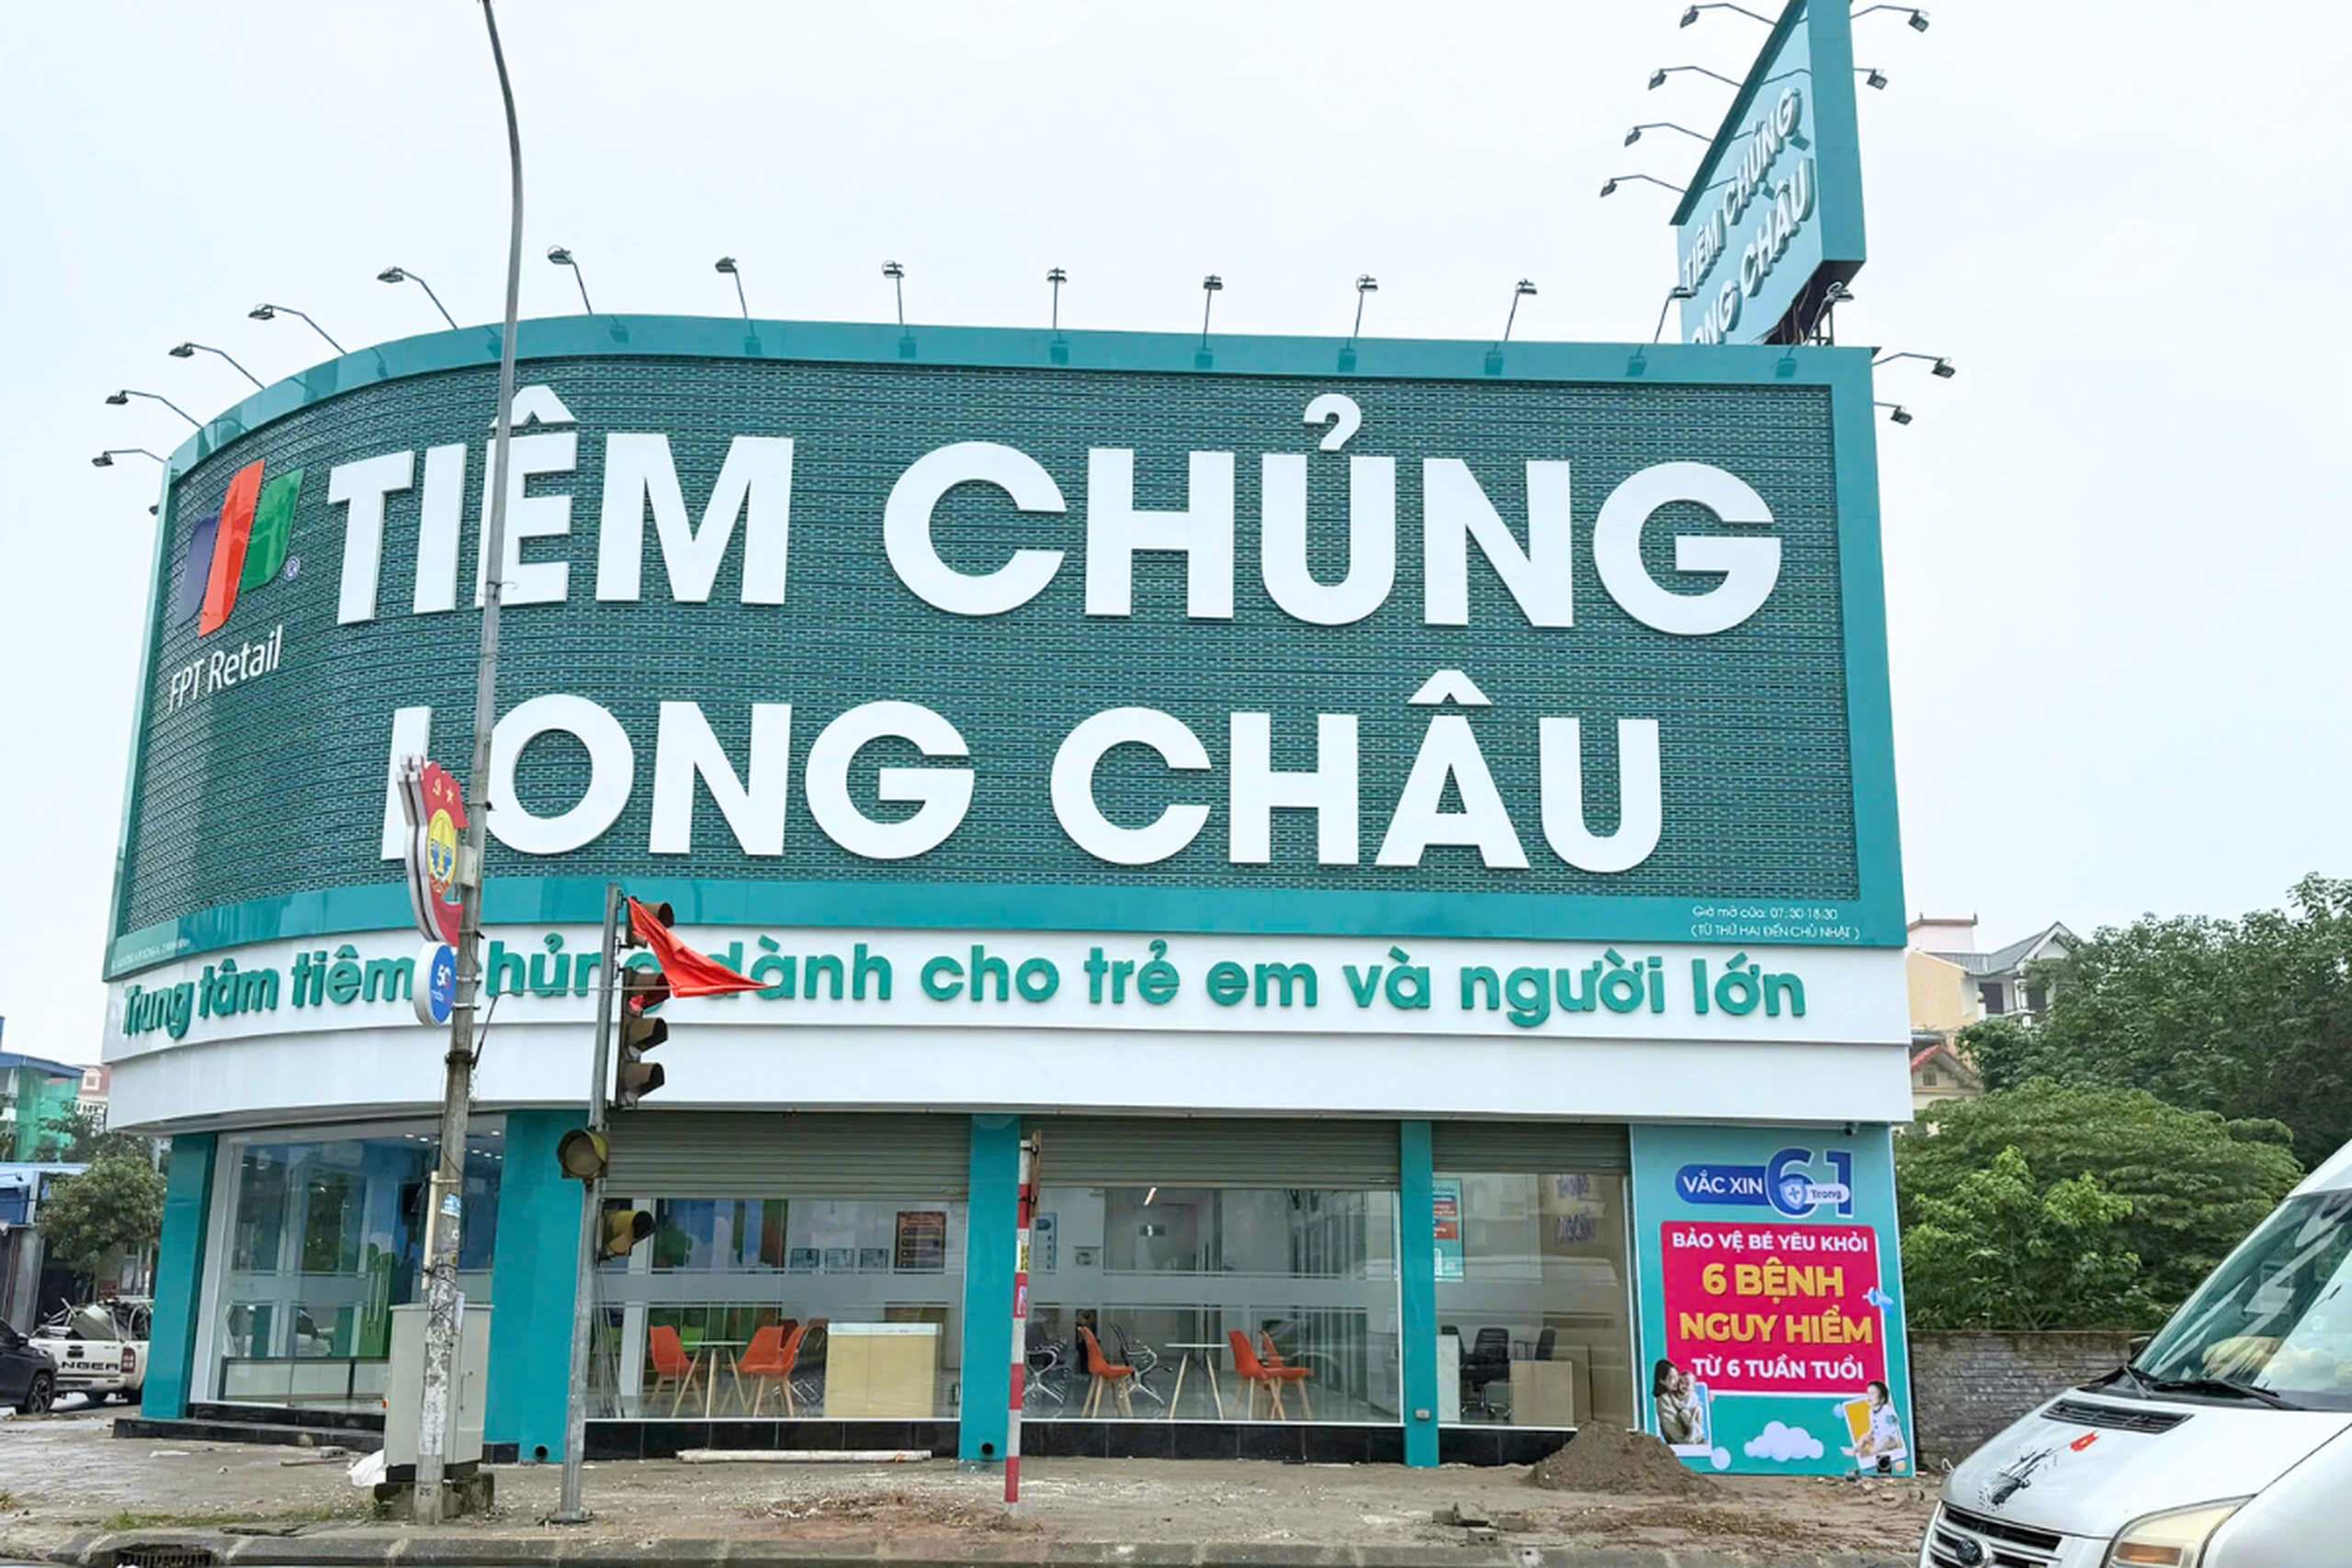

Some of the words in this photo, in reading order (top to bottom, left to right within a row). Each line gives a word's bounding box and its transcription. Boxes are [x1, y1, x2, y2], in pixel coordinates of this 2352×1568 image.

[1741, 158, 1813, 298] CHÂU
[328, 385, 796, 626] TIÊM
[884, 393, 1782, 636] CHỦNG
[168, 658, 205, 713] FPT
[208, 624, 283, 694] Retail
[1049, 670, 1665, 874] CHÂU
[1739, 925, 1760, 936] HAI
[122, 982, 196, 1041] Trung
[198, 957, 280, 1020] tâm
[291, 944, 416, 1010] tiêm
[921, 945, 1060, 1004] cho
[1084, 939, 1181, 1006] trẻ
[1206, 961, 1318, 1008] em
[1343, 945, 1431, 1010] và
[1461, 947, 1666, 1029] người
[1692, 952, 1806, 1018] lớn
[1682, 1169, 1726, 1195] VẮC
[1729, 1177, 1764, 1195] XIN
[1672, 1227, 1714, 1250] BẢO
[1719, 1230, 1745, 1254] VỆ
[1749, 1230, 1774, 1250] BÉ
[1778, 1232, 1816, 1251] YÊU
[1821, 1233, 1869, 1253] KHỎI
[1702, 1262, 1727, 1296] 6
[1736, 1256, 1845, 1304] BỆNH
[1679, 1312, 1778, 1344] NGUY
[1786, 1304, 1873, 1344] HIỂM
[1691, 1355, 1722, 1377] TỪ
[1727, 1360, 1741, 1378] 6
[1745, 1355, 1806, 1379] TUẦN
[1811, 1355, 1864, 1380] TUỔI
